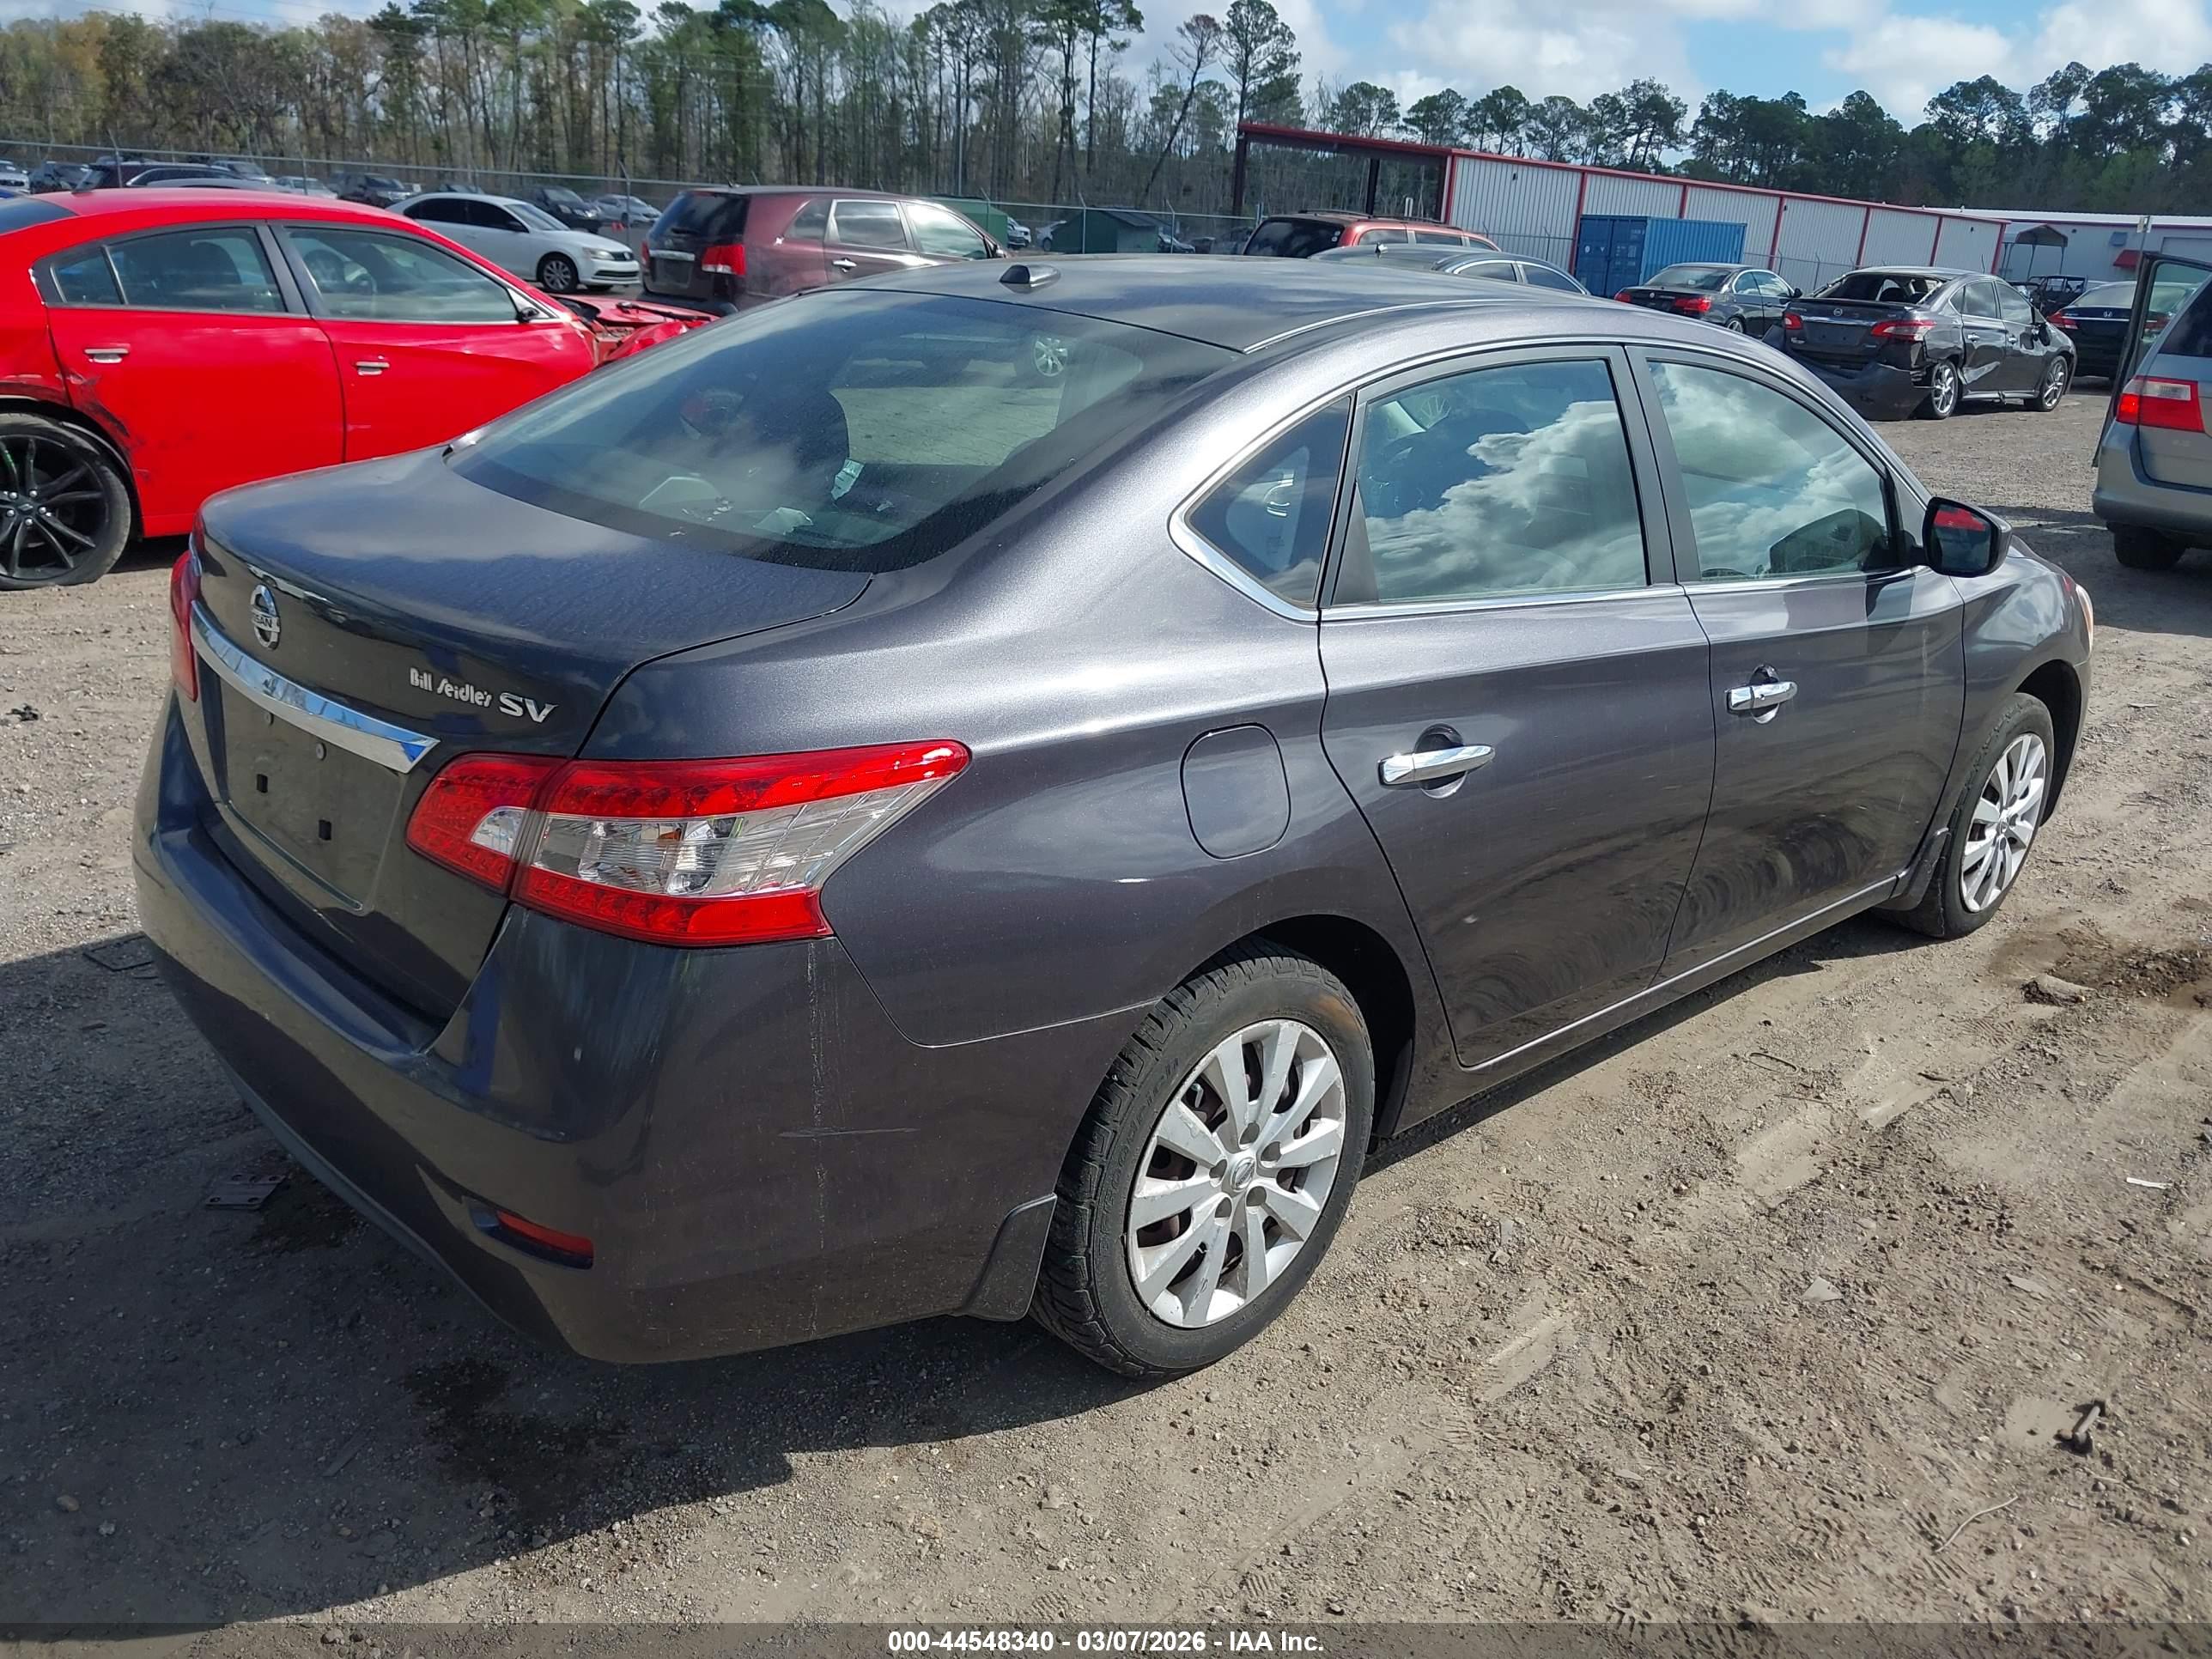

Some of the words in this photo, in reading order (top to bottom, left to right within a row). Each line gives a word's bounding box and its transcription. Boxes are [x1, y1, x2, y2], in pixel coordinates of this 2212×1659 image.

[410, 667, 433, 691] Bill
[436, 678, 493, 708] Seidle's
[499, 692, 559, 723] SV
